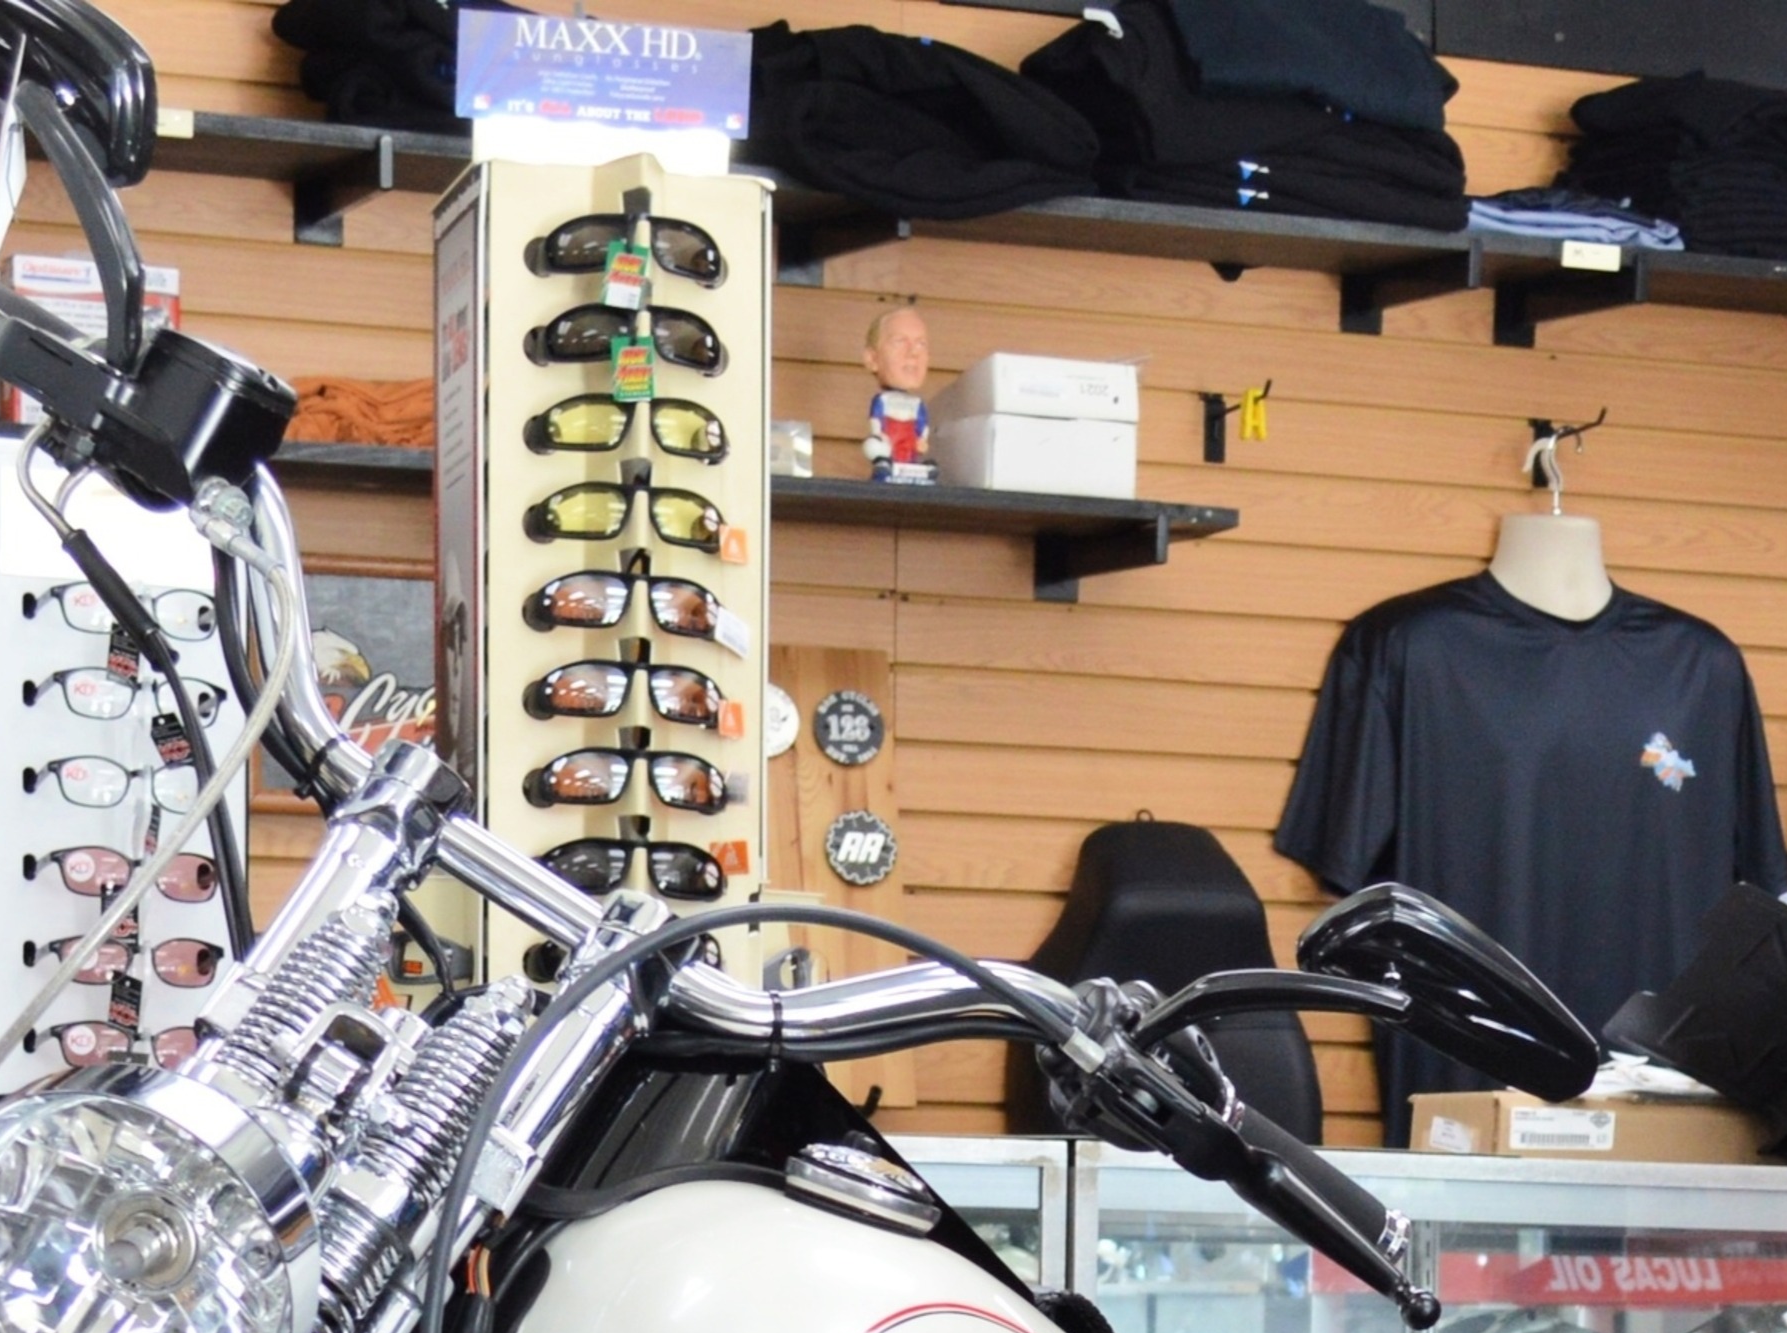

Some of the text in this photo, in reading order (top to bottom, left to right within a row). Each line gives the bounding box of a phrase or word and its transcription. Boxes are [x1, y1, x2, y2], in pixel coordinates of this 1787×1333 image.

[514, 18, 630, 56] MAXX
[577, 105, 621, 119] ABOUT
[625, 109, 651, 122] THE
